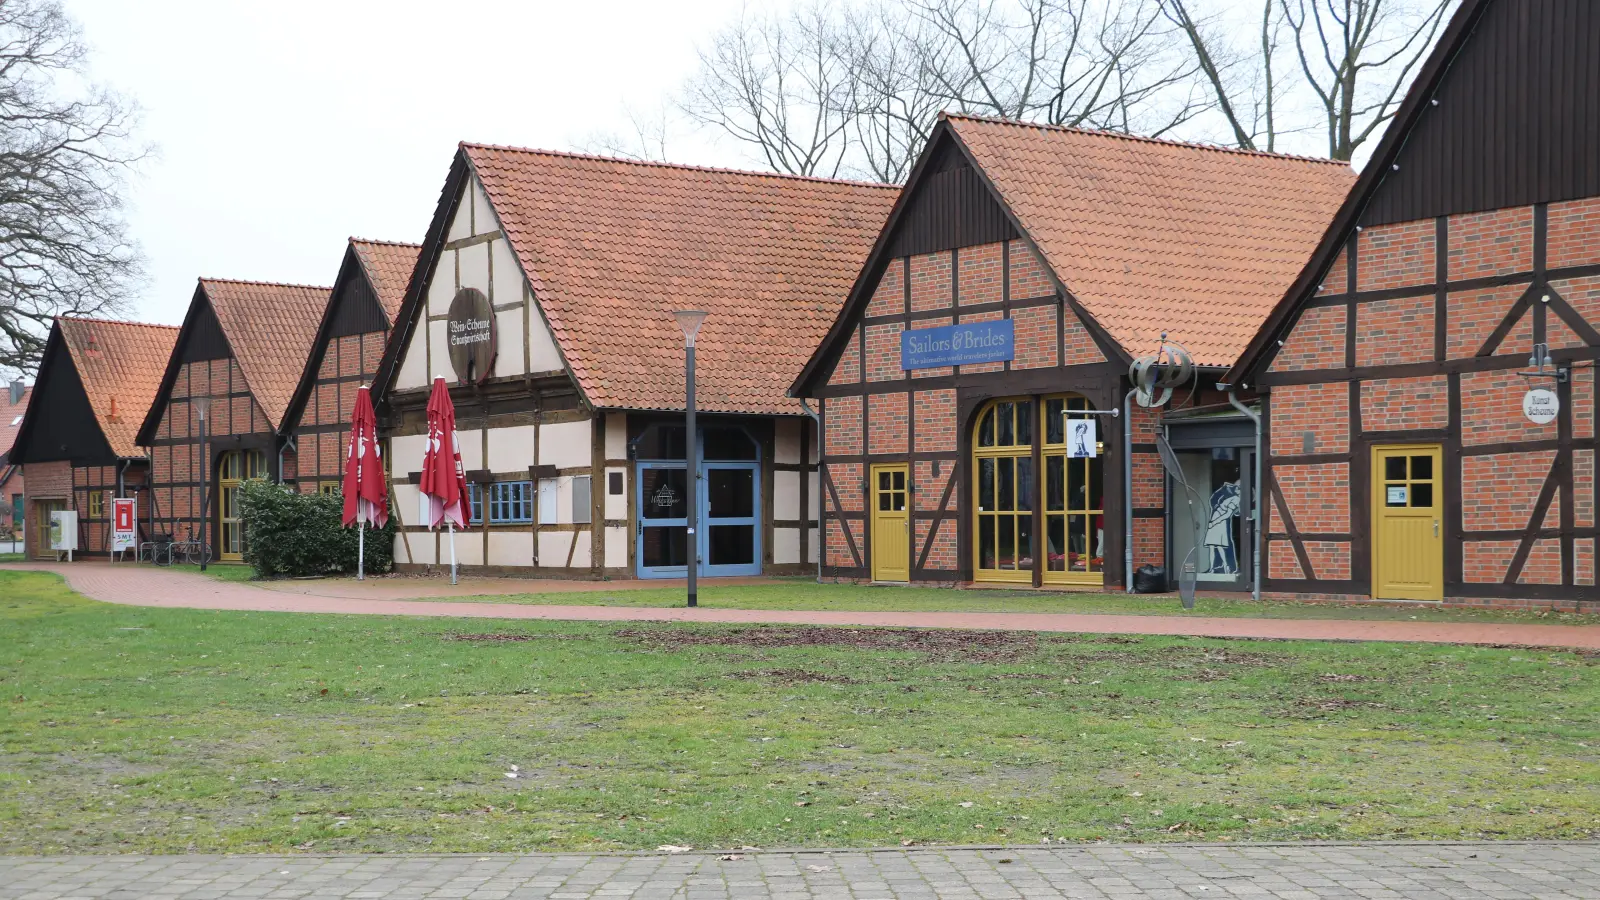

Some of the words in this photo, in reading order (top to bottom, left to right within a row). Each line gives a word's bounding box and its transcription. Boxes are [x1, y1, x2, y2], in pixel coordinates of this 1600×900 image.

[909, 334, 950, 354] Sailors
[952, 331, 963, 351] &
[964, 328, 1005, 349] Brides
[1531, 395, 1550, 405] Kunst
